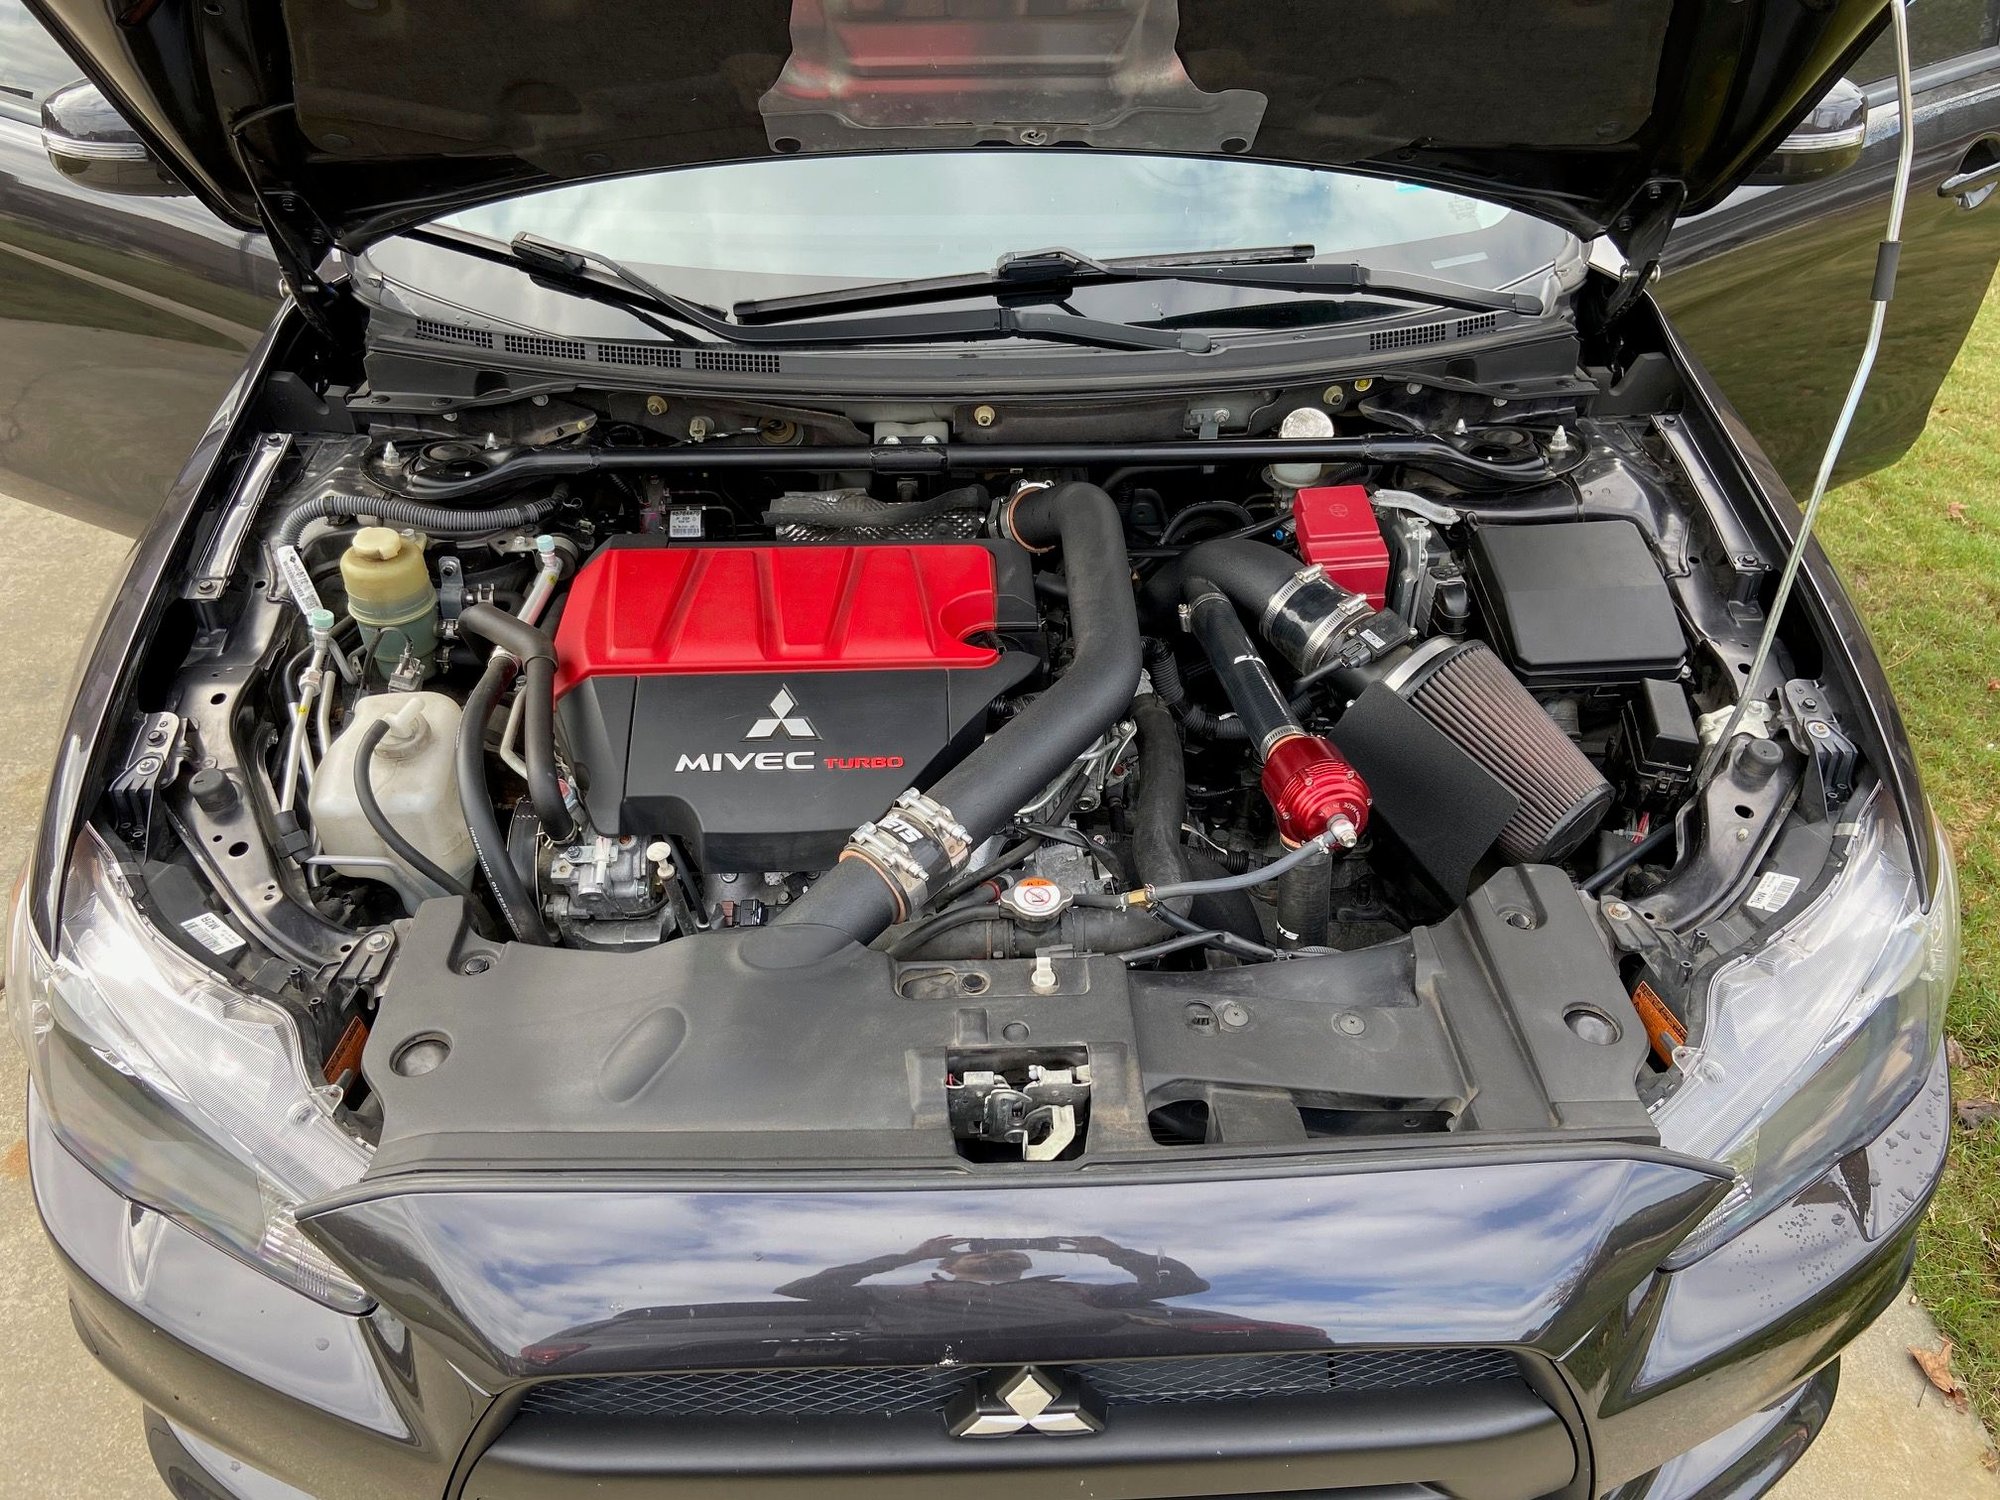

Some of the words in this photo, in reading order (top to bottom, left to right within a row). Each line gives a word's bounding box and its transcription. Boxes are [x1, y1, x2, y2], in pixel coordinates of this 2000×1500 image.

[674, 751, 816, 772] MIVEC
[823, 756, 904, 769] TURBO
[881, 817, 924, 843] ETS
[201, 915, 221, 930] M2R
